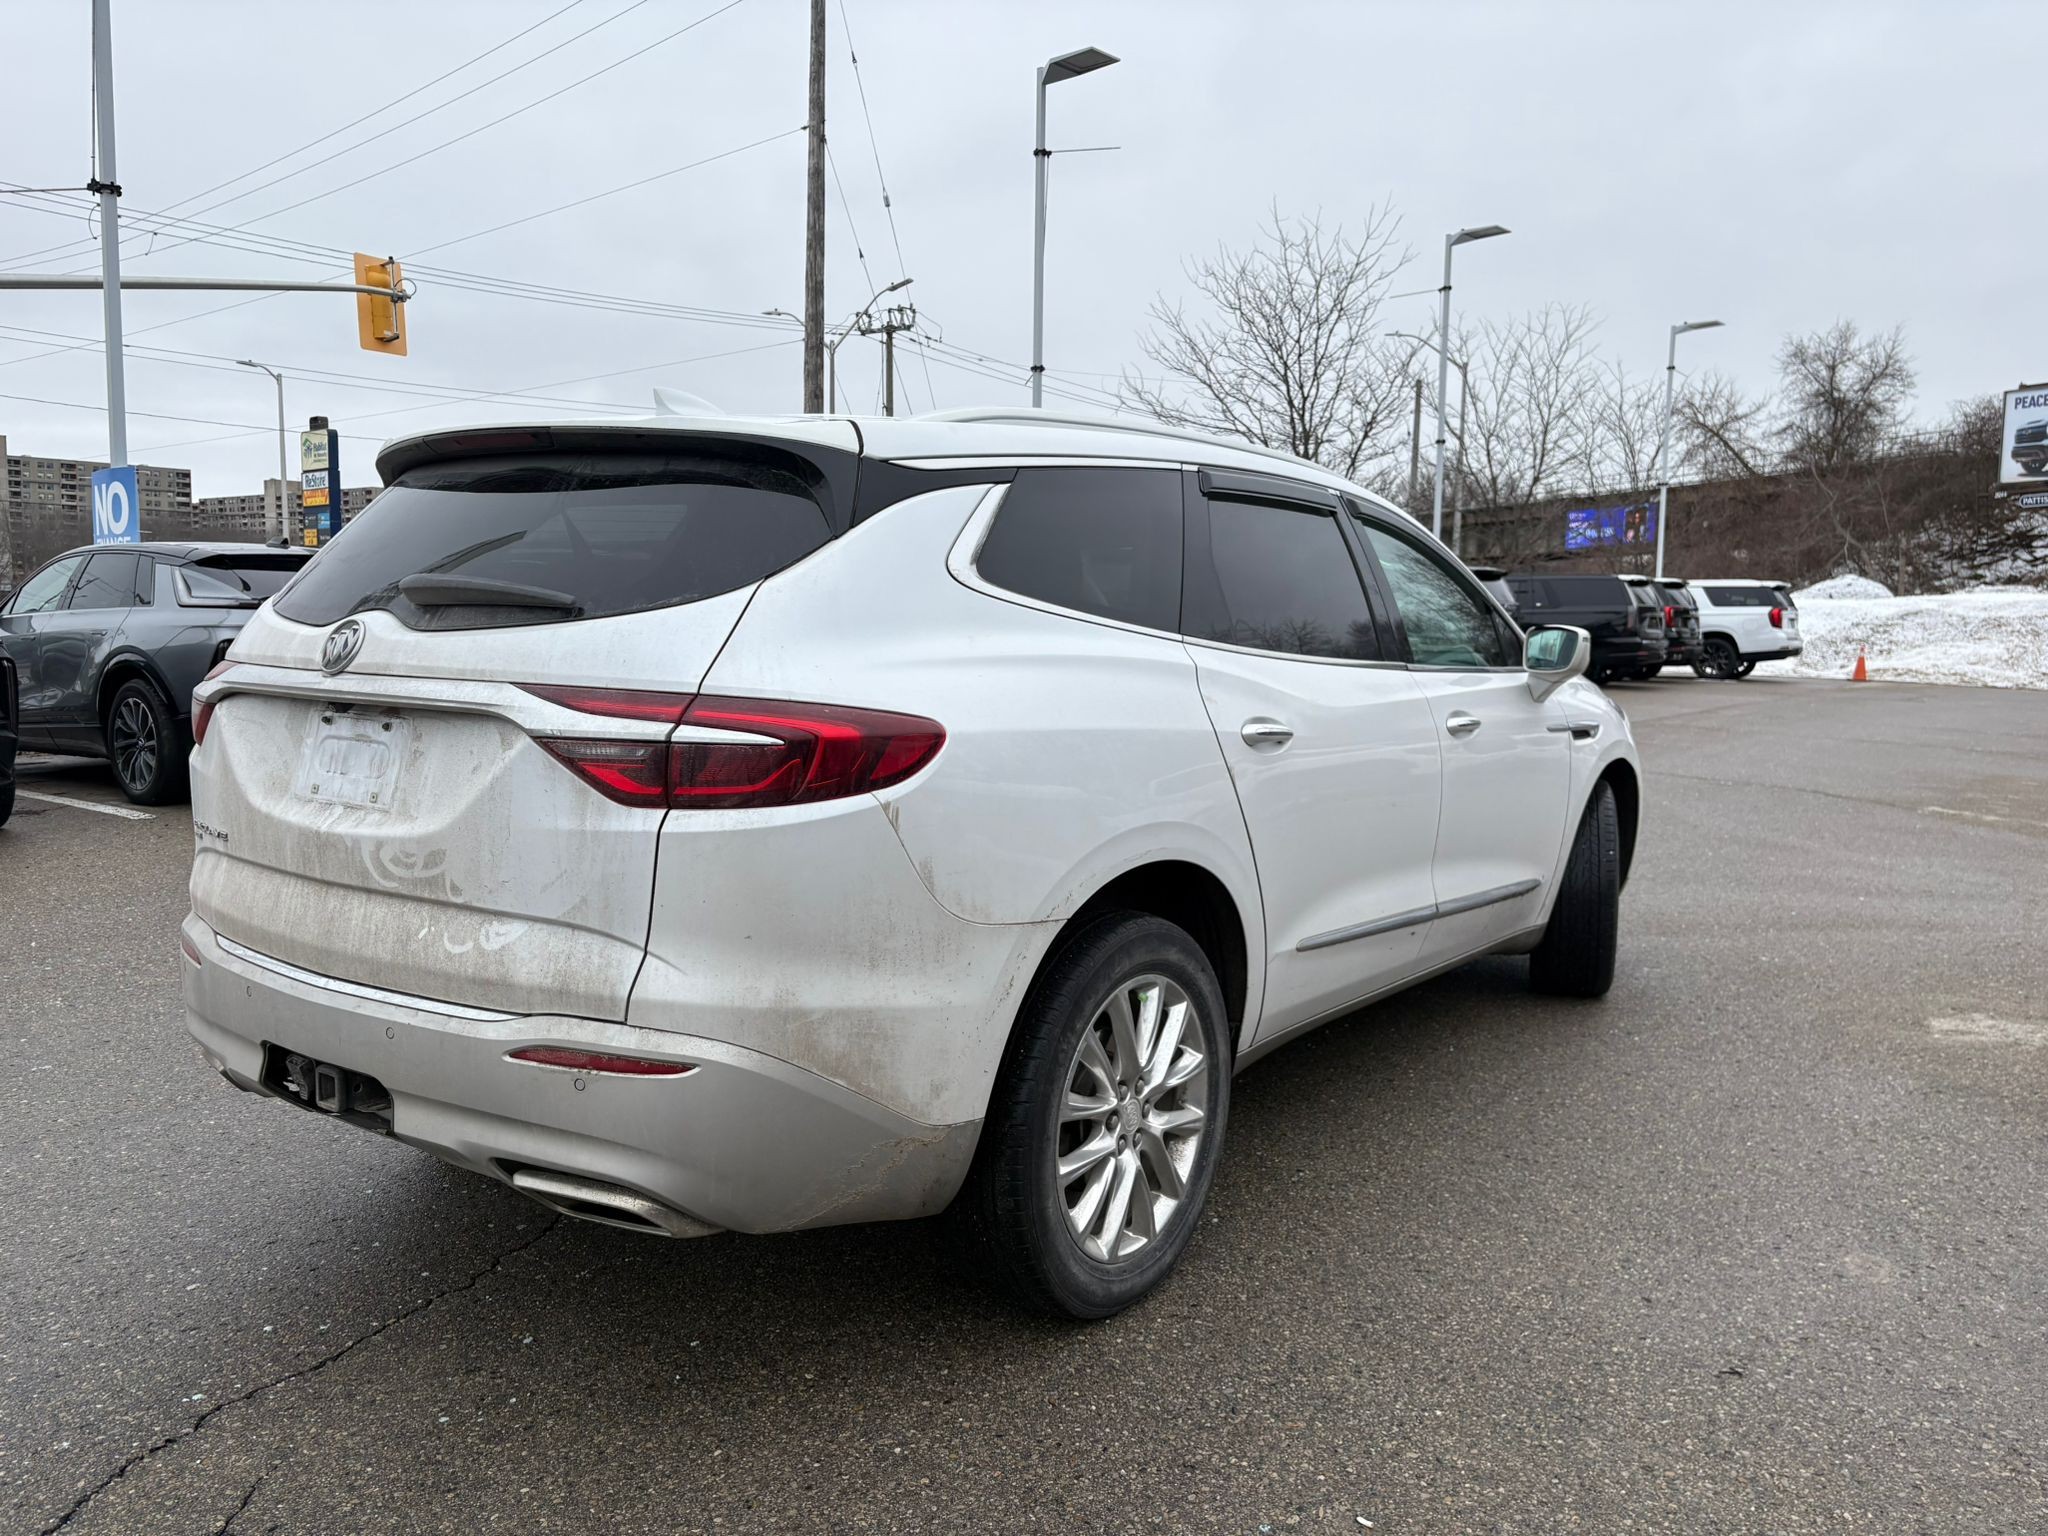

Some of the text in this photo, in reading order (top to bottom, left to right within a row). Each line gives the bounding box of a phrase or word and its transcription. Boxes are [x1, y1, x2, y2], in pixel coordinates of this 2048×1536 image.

[2015, 394, 2048, 409] PEACE
[305, 474, 326, 488] ReStore
[94, 481, 129, 535] NO
